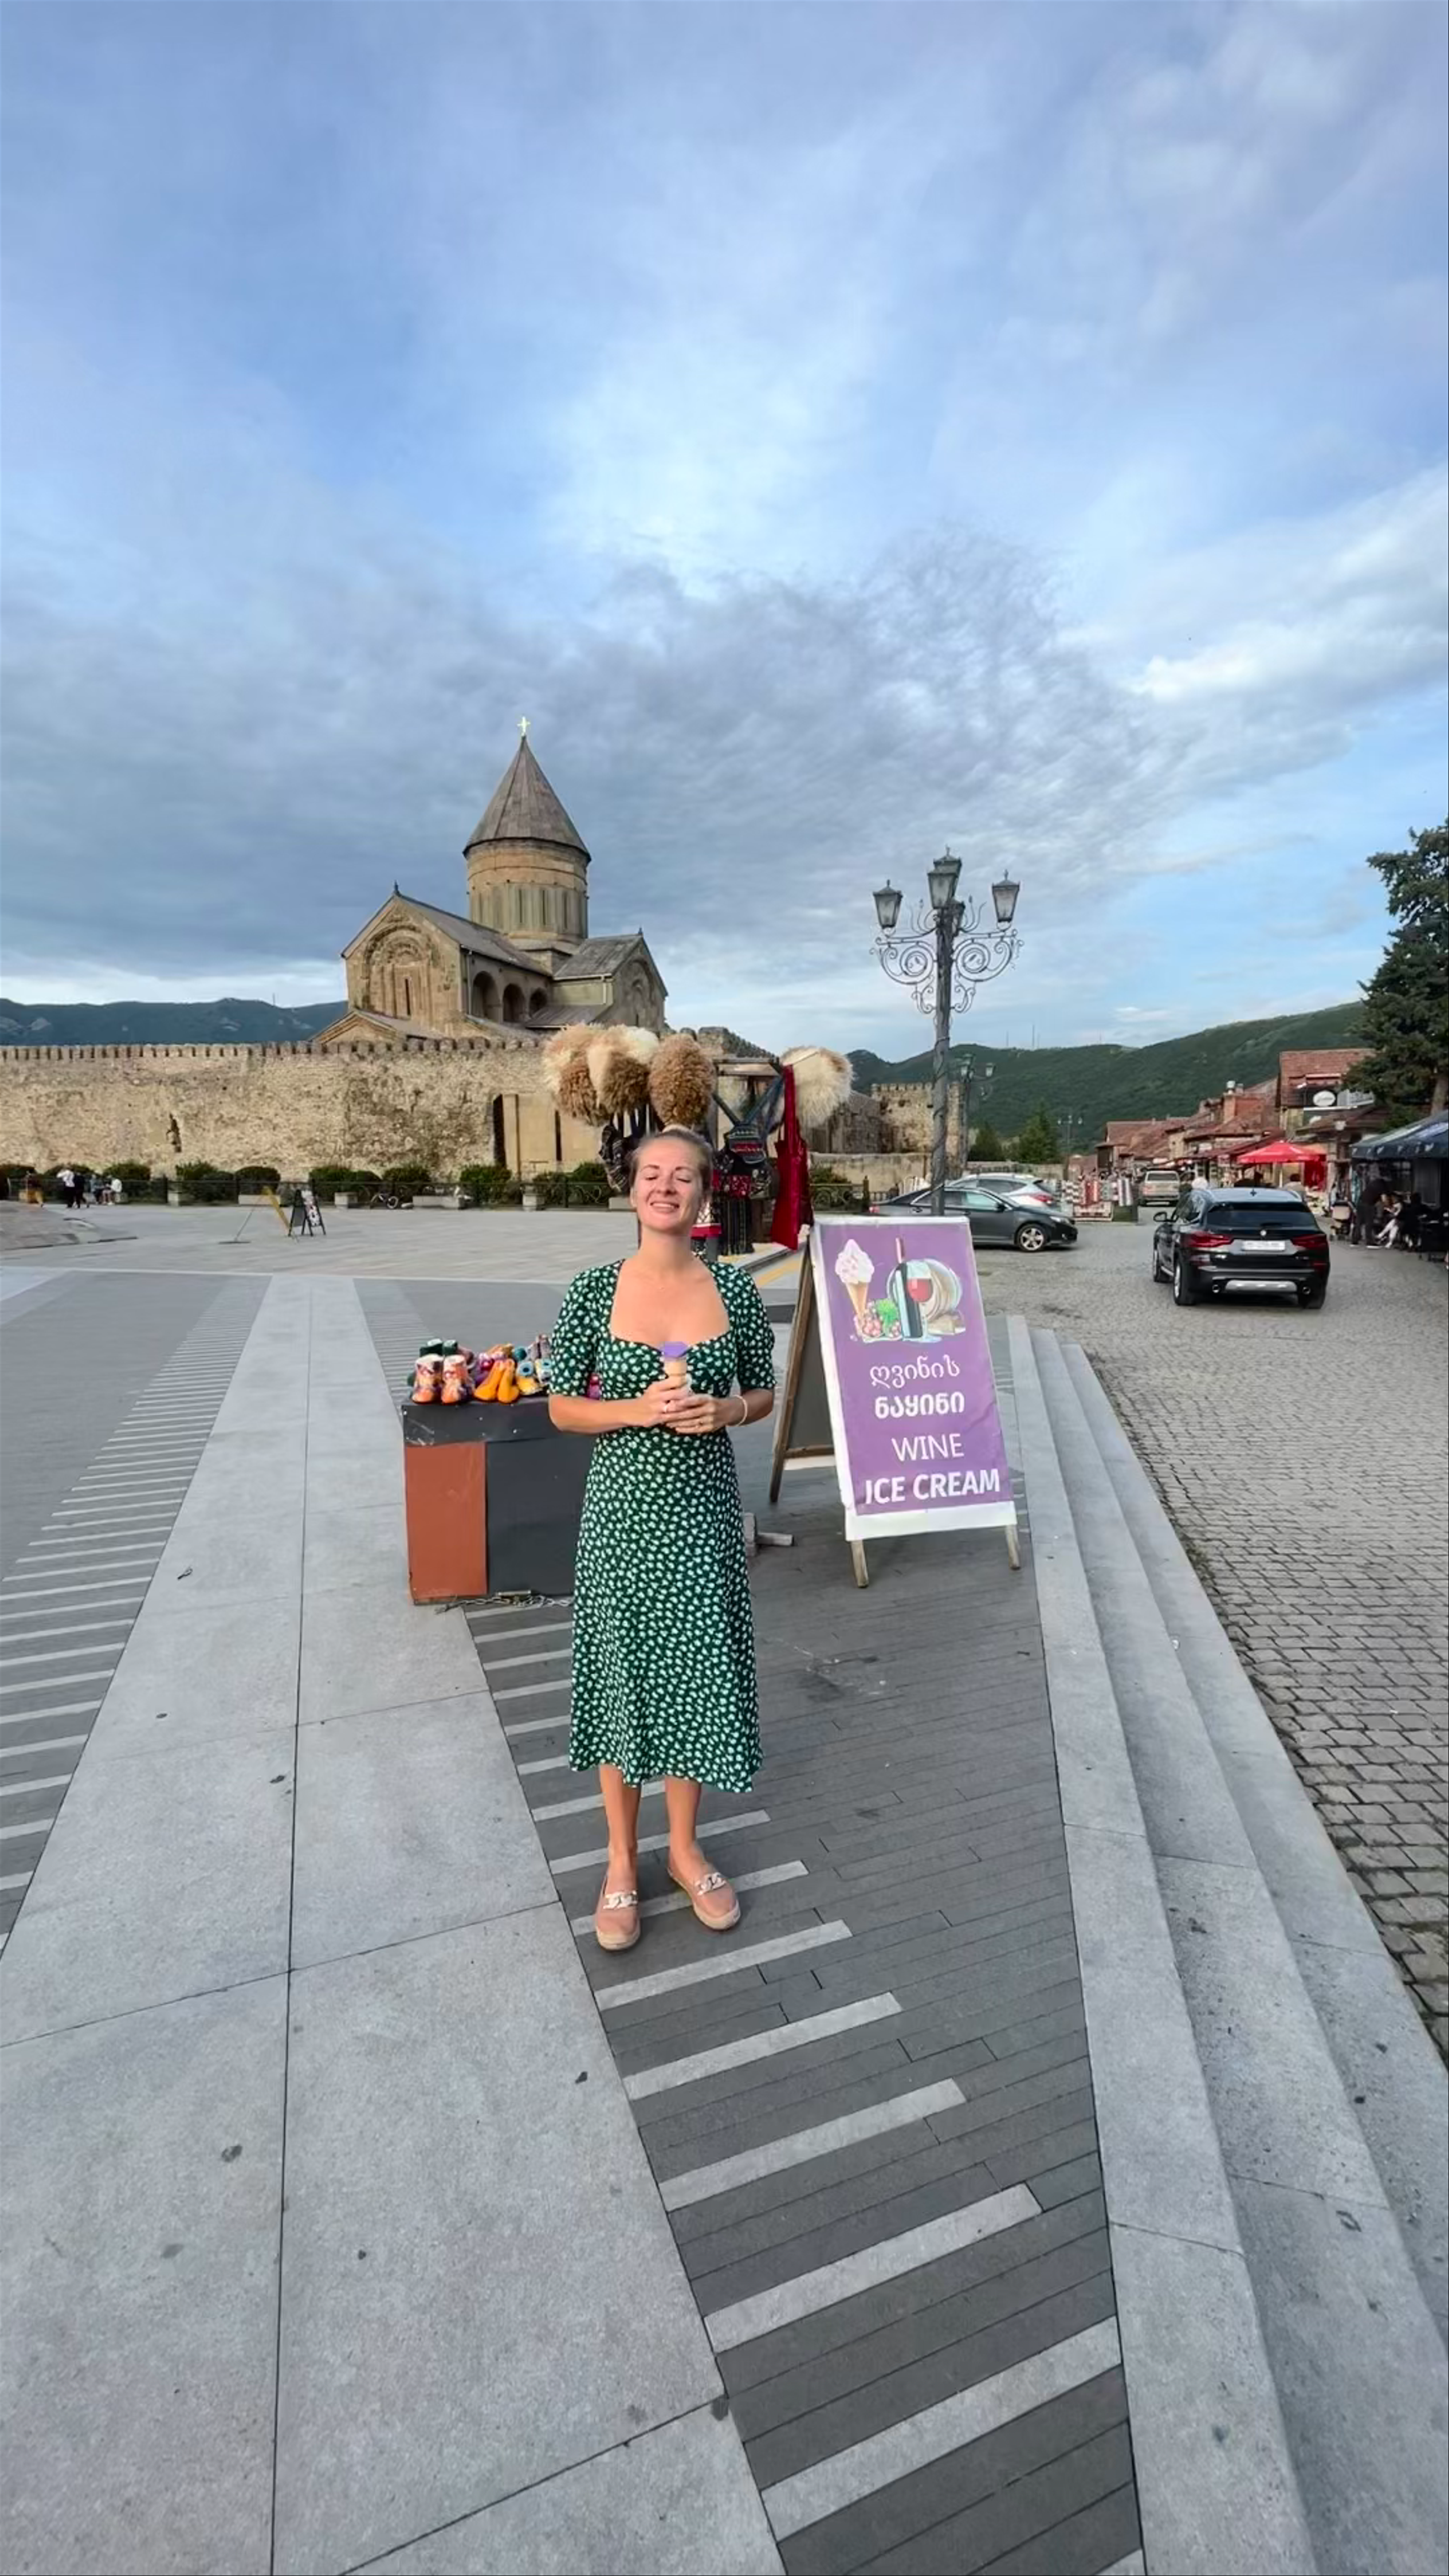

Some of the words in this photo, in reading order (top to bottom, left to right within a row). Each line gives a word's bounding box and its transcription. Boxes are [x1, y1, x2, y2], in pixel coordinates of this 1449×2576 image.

[870, 1354, 960, 1389] ღვინის
[891, 1433, 964, 1461] WINE
[865, 1476, 906, 1504] ICE
[913, 1469, 1000, 1500] CREAM
